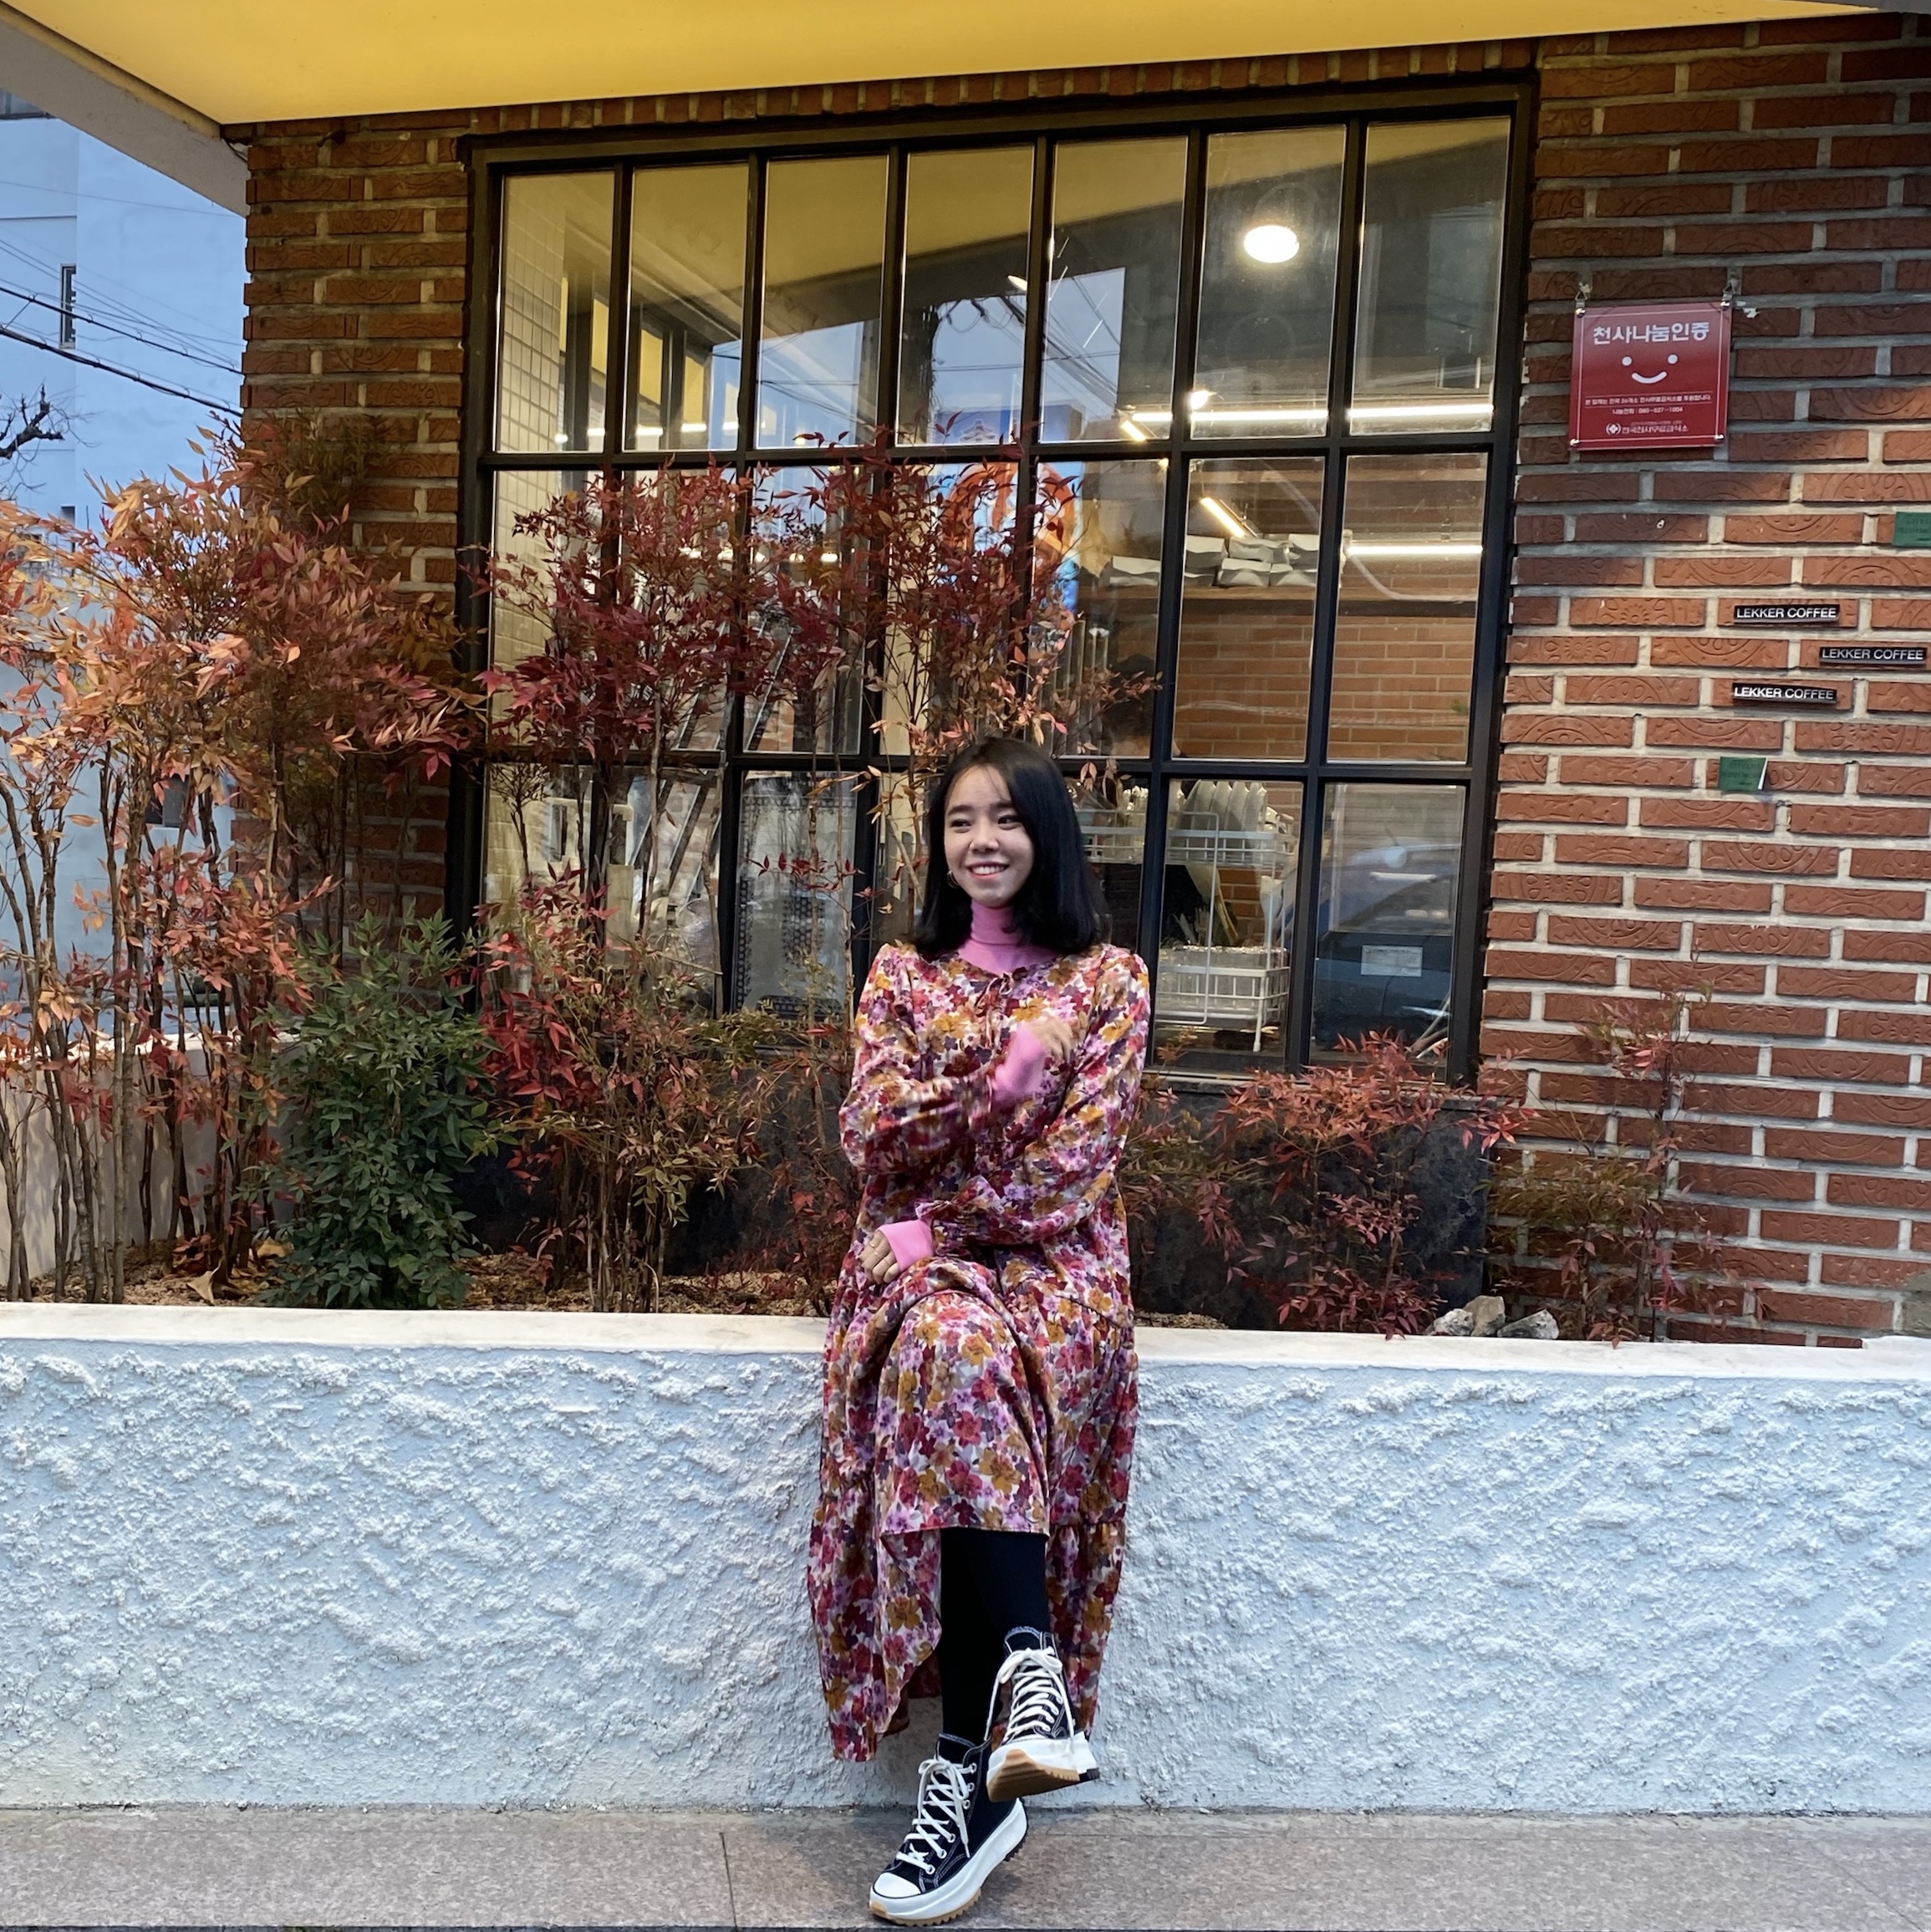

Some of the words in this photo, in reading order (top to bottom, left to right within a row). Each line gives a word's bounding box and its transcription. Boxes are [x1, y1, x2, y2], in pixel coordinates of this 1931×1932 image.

[1593, 322, 1709, 344] 천사나눔인증
[1737, 608, 1784, 619] LEKKER
[1787, 607, 1837, 619] COFFEE
[1822, 649, 1871, 659] LEKKER
[1874, 650, 1923, 660] COFFEE
[1735, 687, 1782, 698] LEKKER
[1785, 689, 1834, 699] COFFEE
